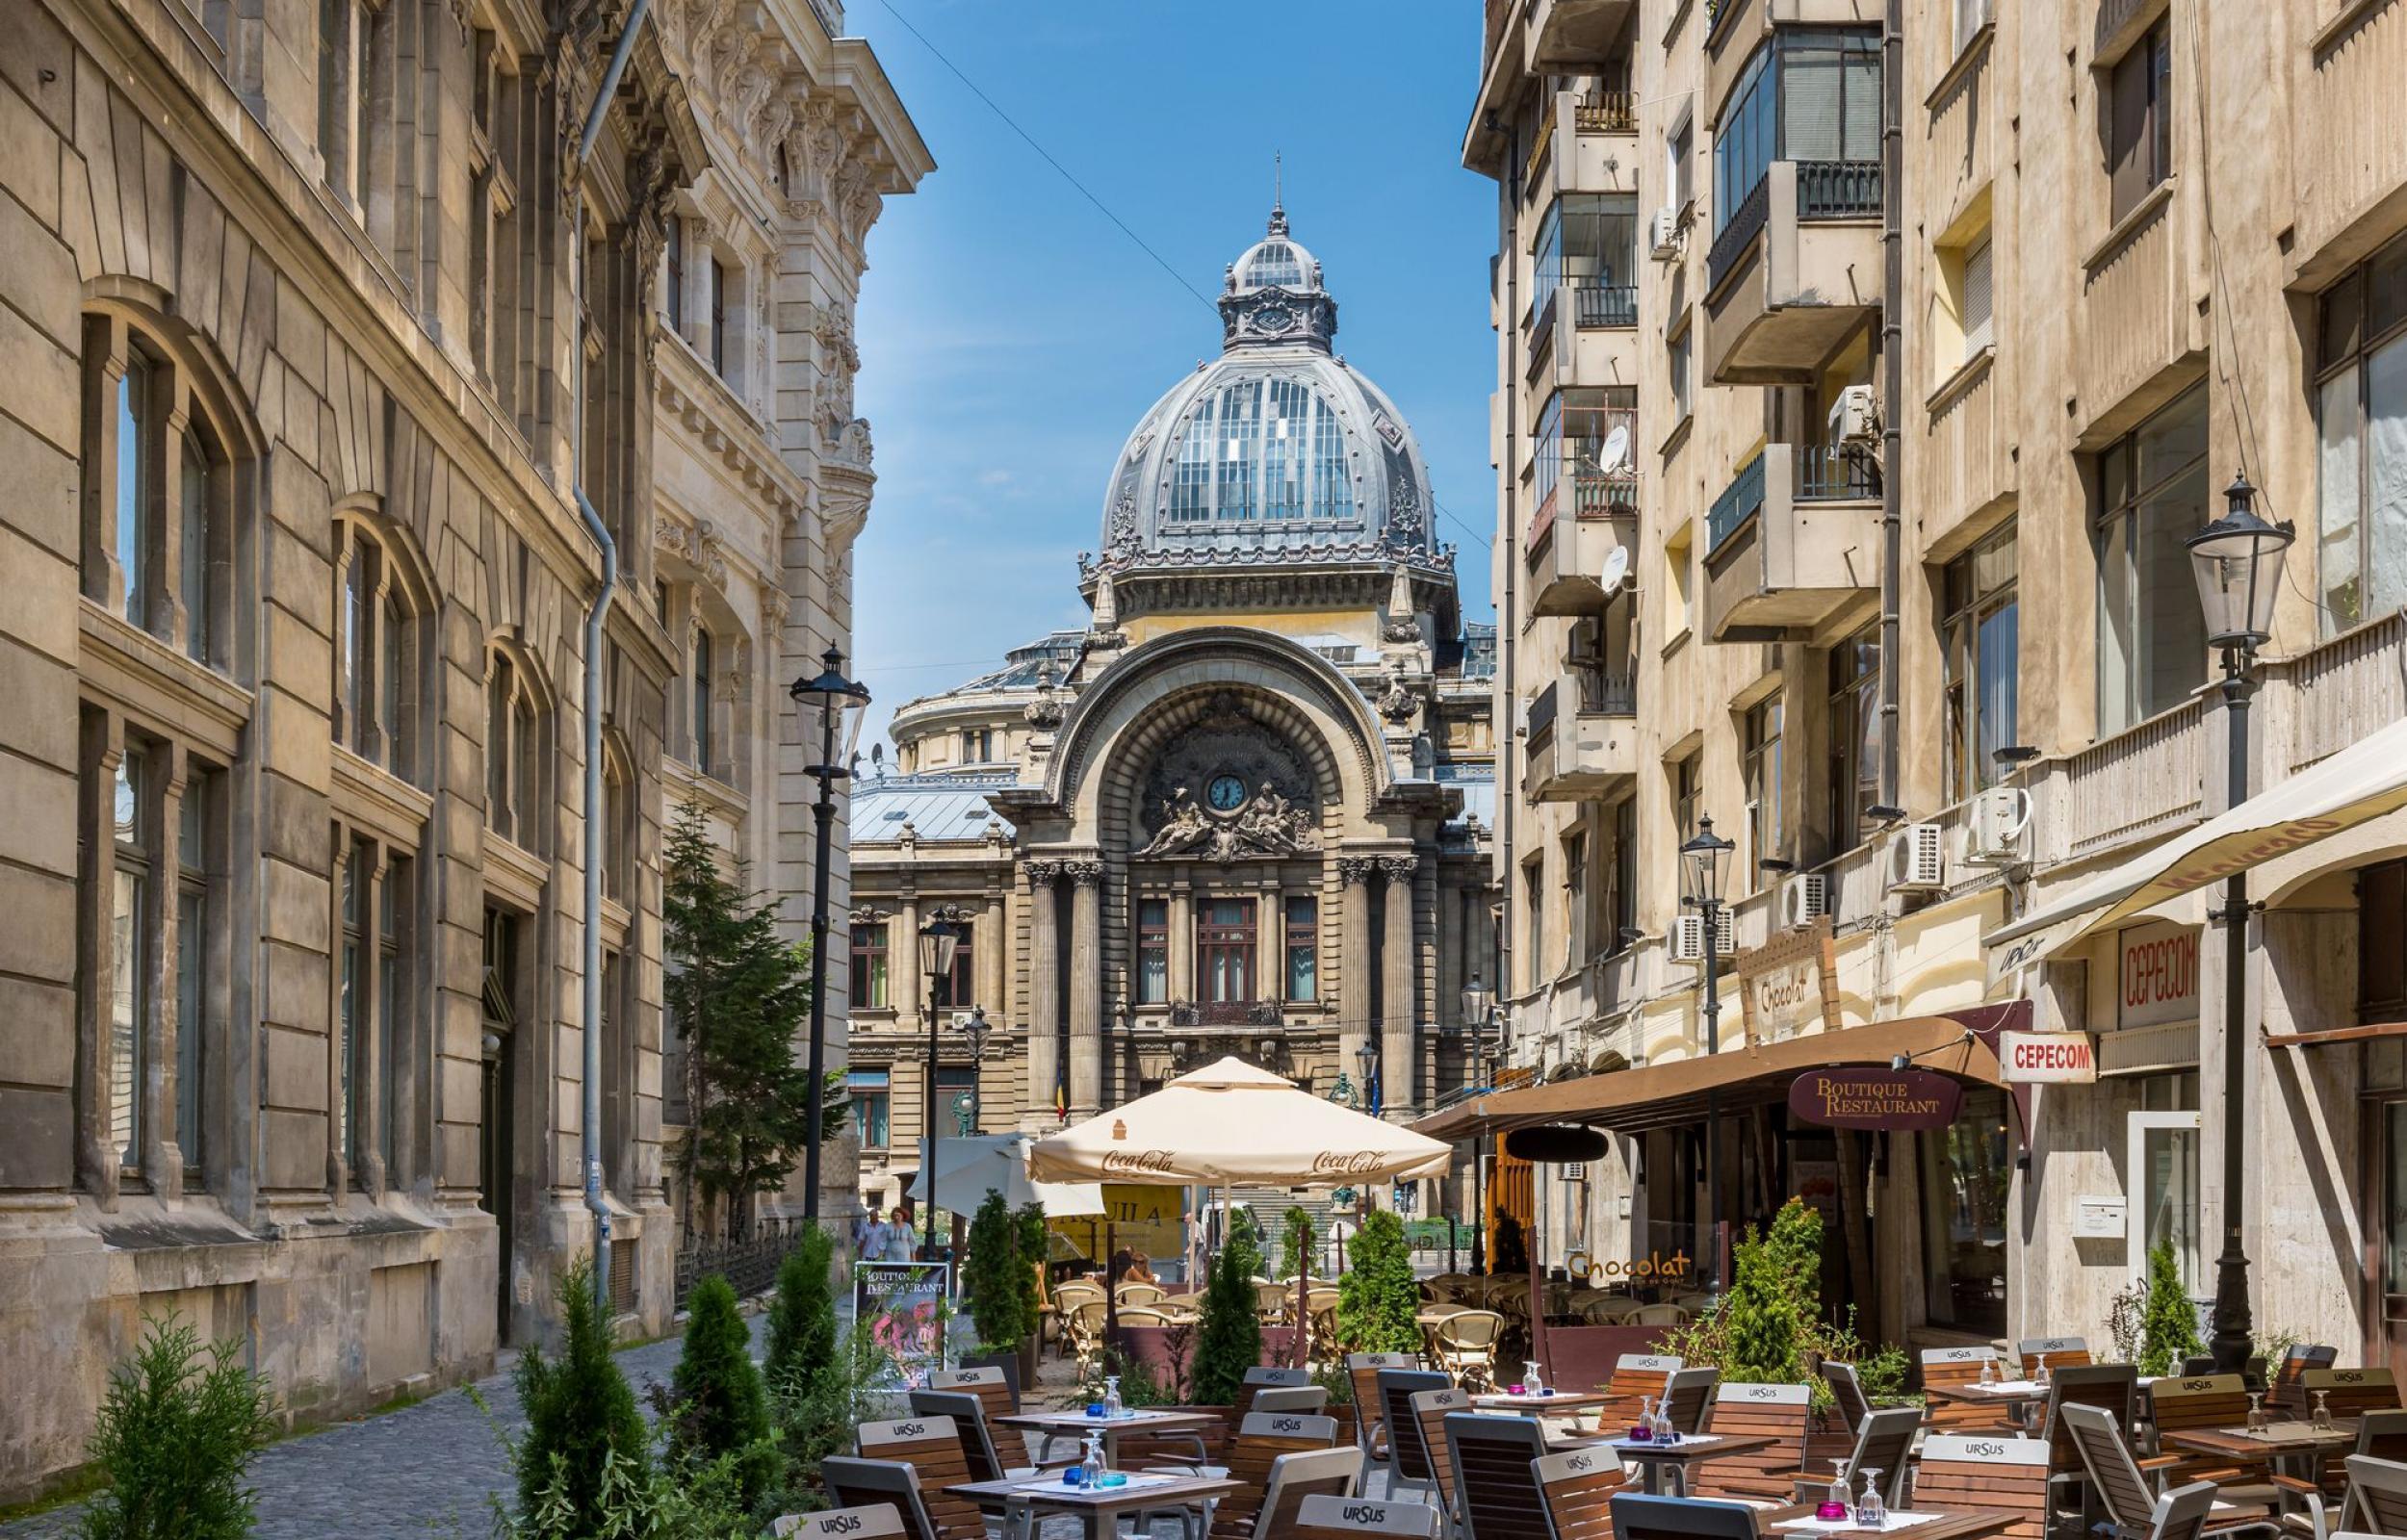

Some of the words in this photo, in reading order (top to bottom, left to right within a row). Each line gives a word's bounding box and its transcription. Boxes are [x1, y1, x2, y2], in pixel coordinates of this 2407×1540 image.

[2126, 933, 2196, 1007] CEPECOM
[1761, 967, 1807, 1014] Chocolat
[2015, 1044, 2090, 1069] CEPECOM
[1817, 1078, 1907, 1098] BOUTIQUE
[1825, 1093, 1940, 1116] RESTAURANT
[1101, 1149, 1176, 1171] Coca-Cola
[1313, 1150, 1392, 1173] Coca-Cola
[1568, 1249, 1691, 1279] Chocolat
[1947, 1349, 1972, 1359] URSUS
[1638, 1357, 1659, 1368] URSUS
[955, 1372, 980, 1383] URSUS
[2334, 1371, 2364, 1383] URSUS
[1748, 1387, 1777, 1399] URSUS
[2183, 1379, 2213, 1392] URSUS
[893, 1423, 925, 1436] URSUS
[1272, 1418, 1302, 1432] URSUS
[1965, 1442, 2006, 1456] URSUS
[1566, 1456, 1593, 1470] URSUS
[1342, 1505, 1386, 1524] URSUS
[819, 1515, 862, 1534] URSUS
